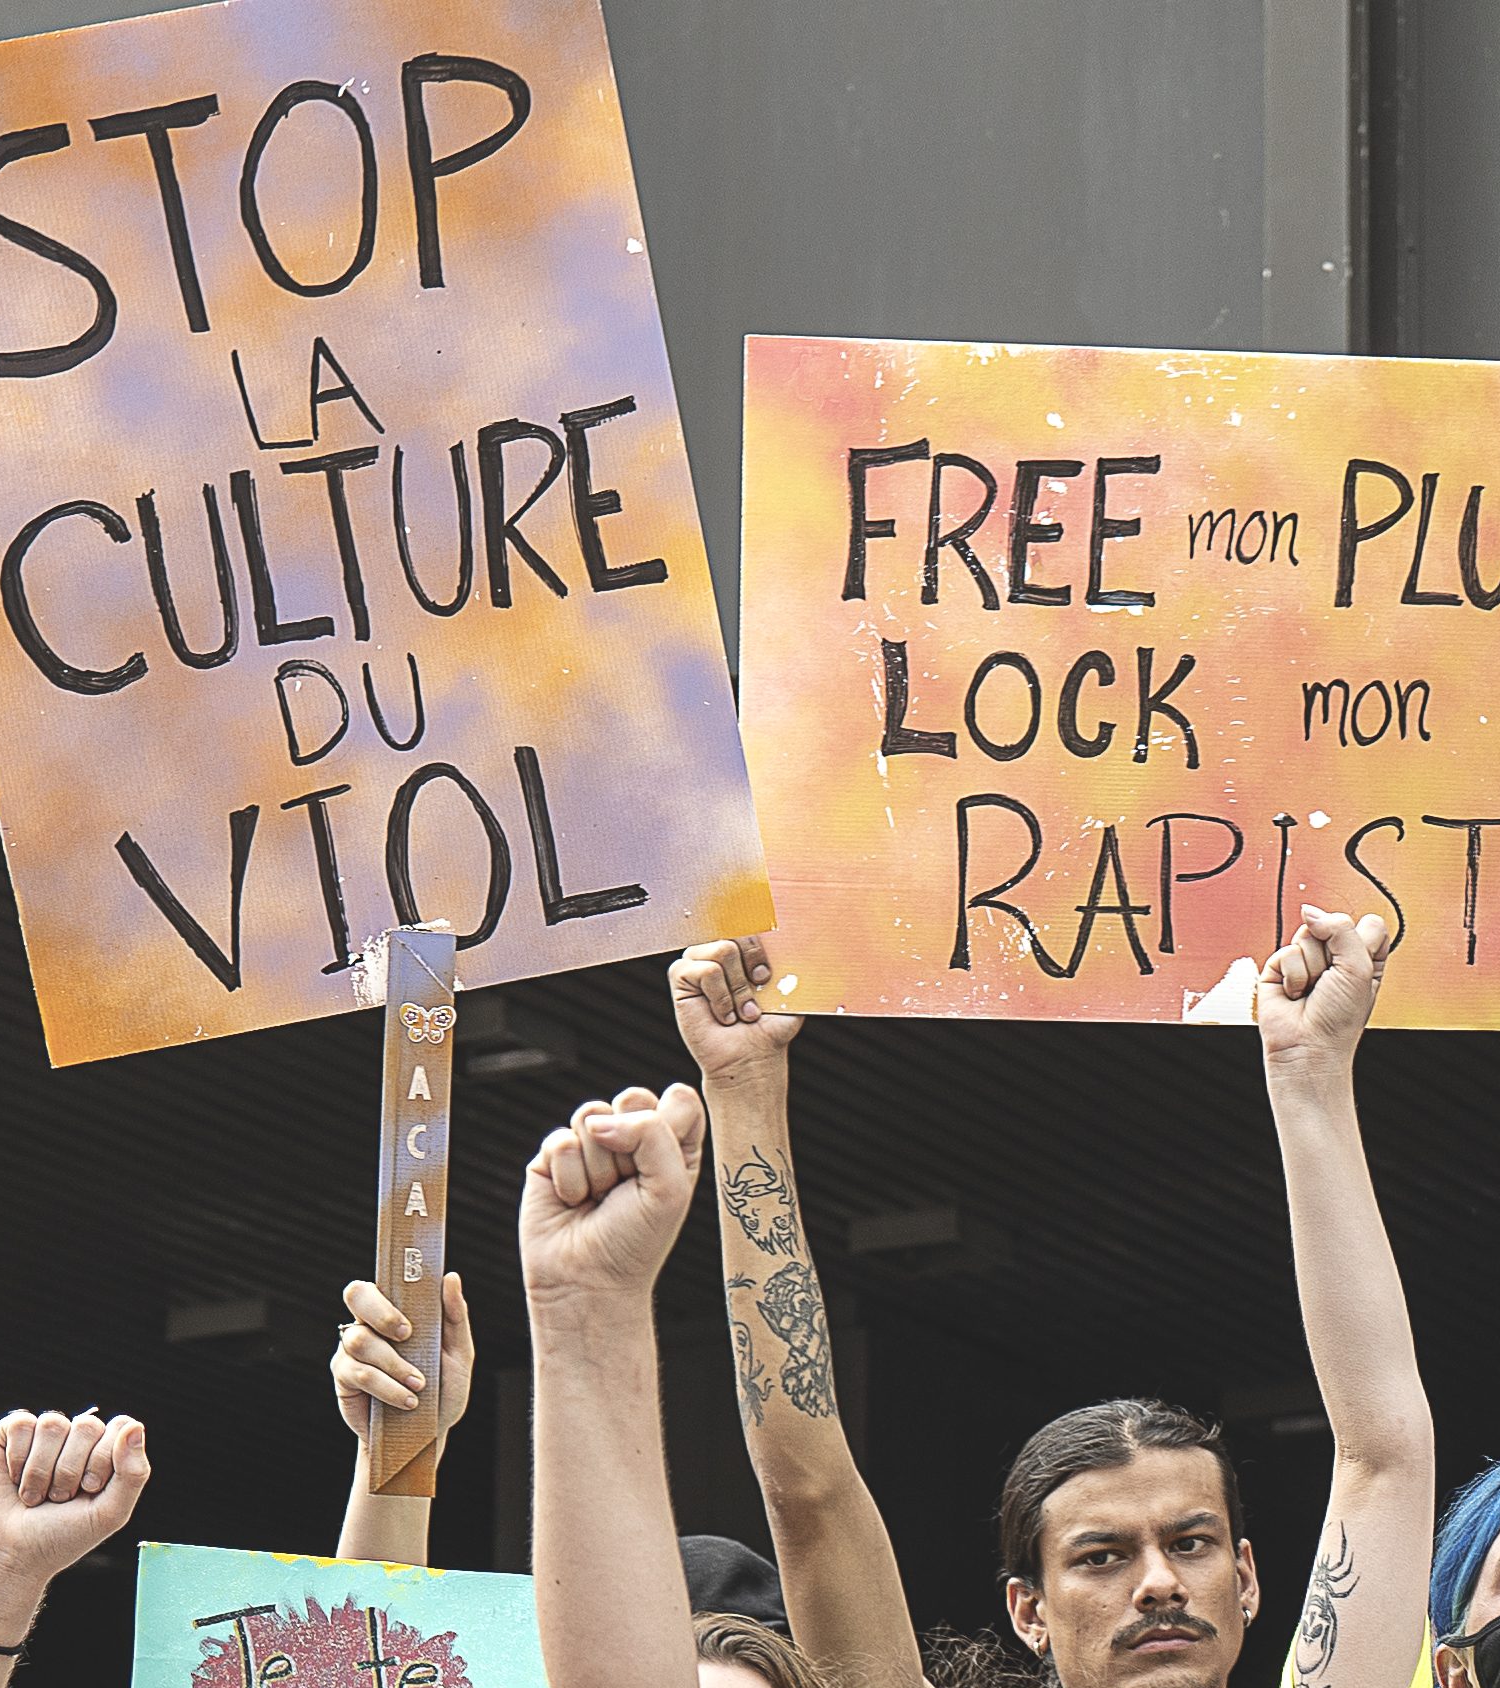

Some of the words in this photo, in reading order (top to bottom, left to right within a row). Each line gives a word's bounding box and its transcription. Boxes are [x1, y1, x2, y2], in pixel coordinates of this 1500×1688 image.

[230, 336, 386, 451] LA
[0, 395, 669, 695] CULTURE
[841, 437, 1161, 611] FREE
[1187, 505, 1301, 568] mon
[275, 651, 425, 766] DU
[880, 638, 1200, 770] LOCK
[1302, 675, 1431, 747] mon
[113, 745, 650, 993] VIOL
